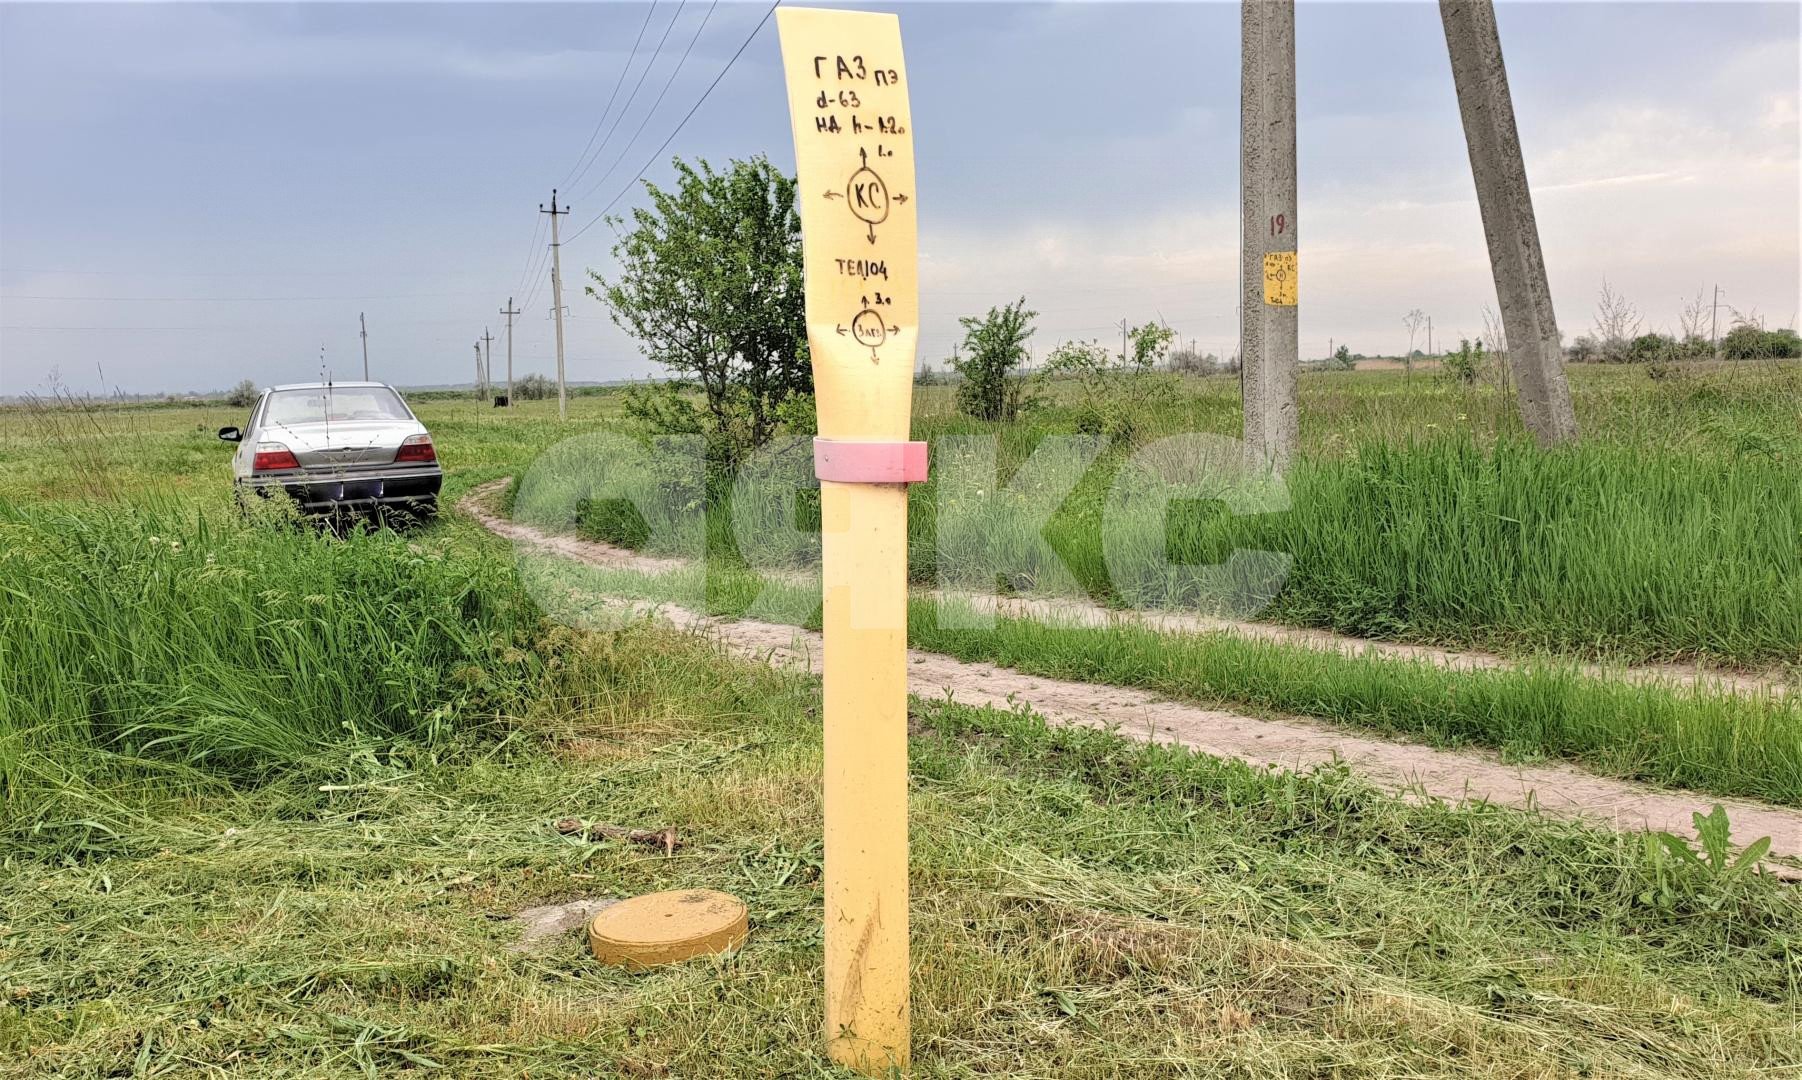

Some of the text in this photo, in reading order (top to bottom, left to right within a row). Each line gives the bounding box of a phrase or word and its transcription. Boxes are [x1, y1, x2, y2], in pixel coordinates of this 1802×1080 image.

[813, 55, 867, 80] ГАЗ
[816, 90, 861, 109] d-63
[854, 182, 882, 209] КС
[1270, 214, 1285, 236] 19
